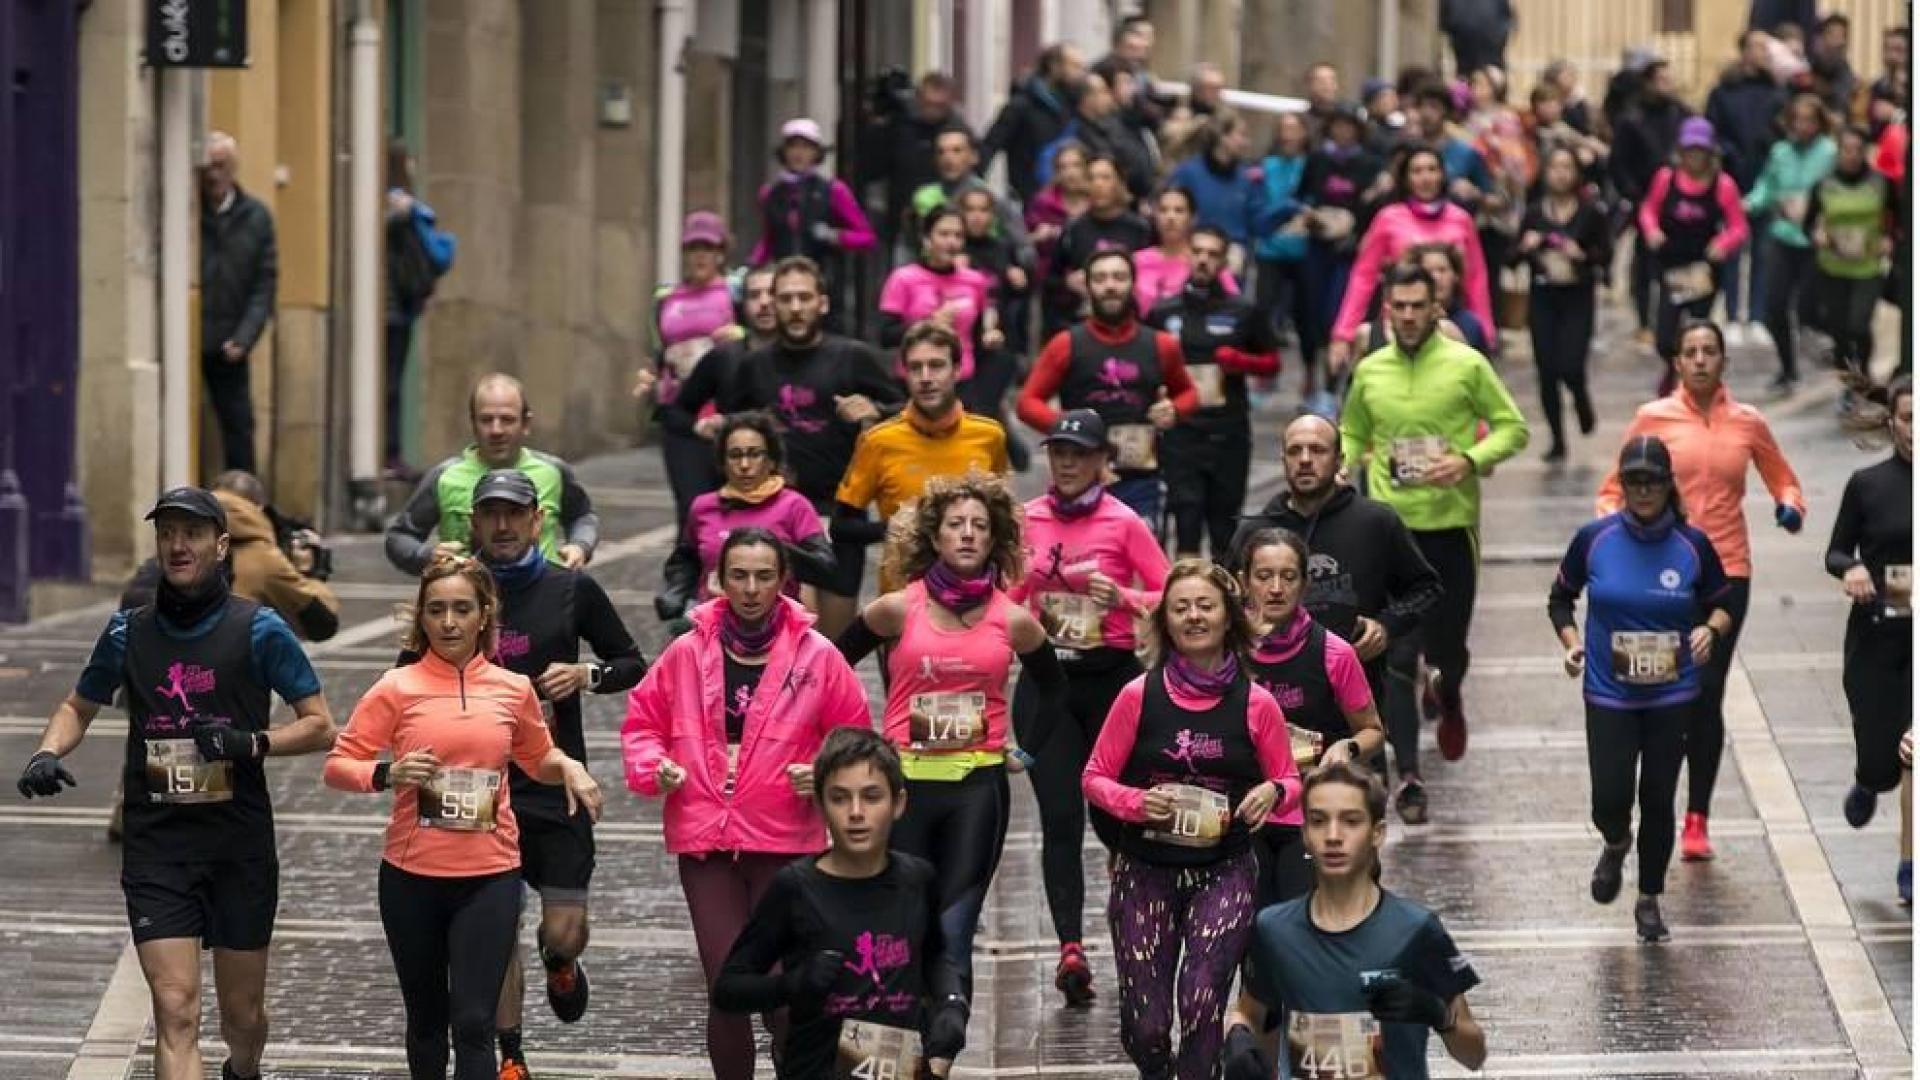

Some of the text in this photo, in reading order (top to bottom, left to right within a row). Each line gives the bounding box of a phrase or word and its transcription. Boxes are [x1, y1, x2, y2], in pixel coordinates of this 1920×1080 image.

[1056, 614, 1086, 640] 79
[928, 714, 972, 739] 176
[441, 791, 478, 818] 59
[1171, 808, 1201, 836] 10
[1300, 1045, 1369, 1079] 446
